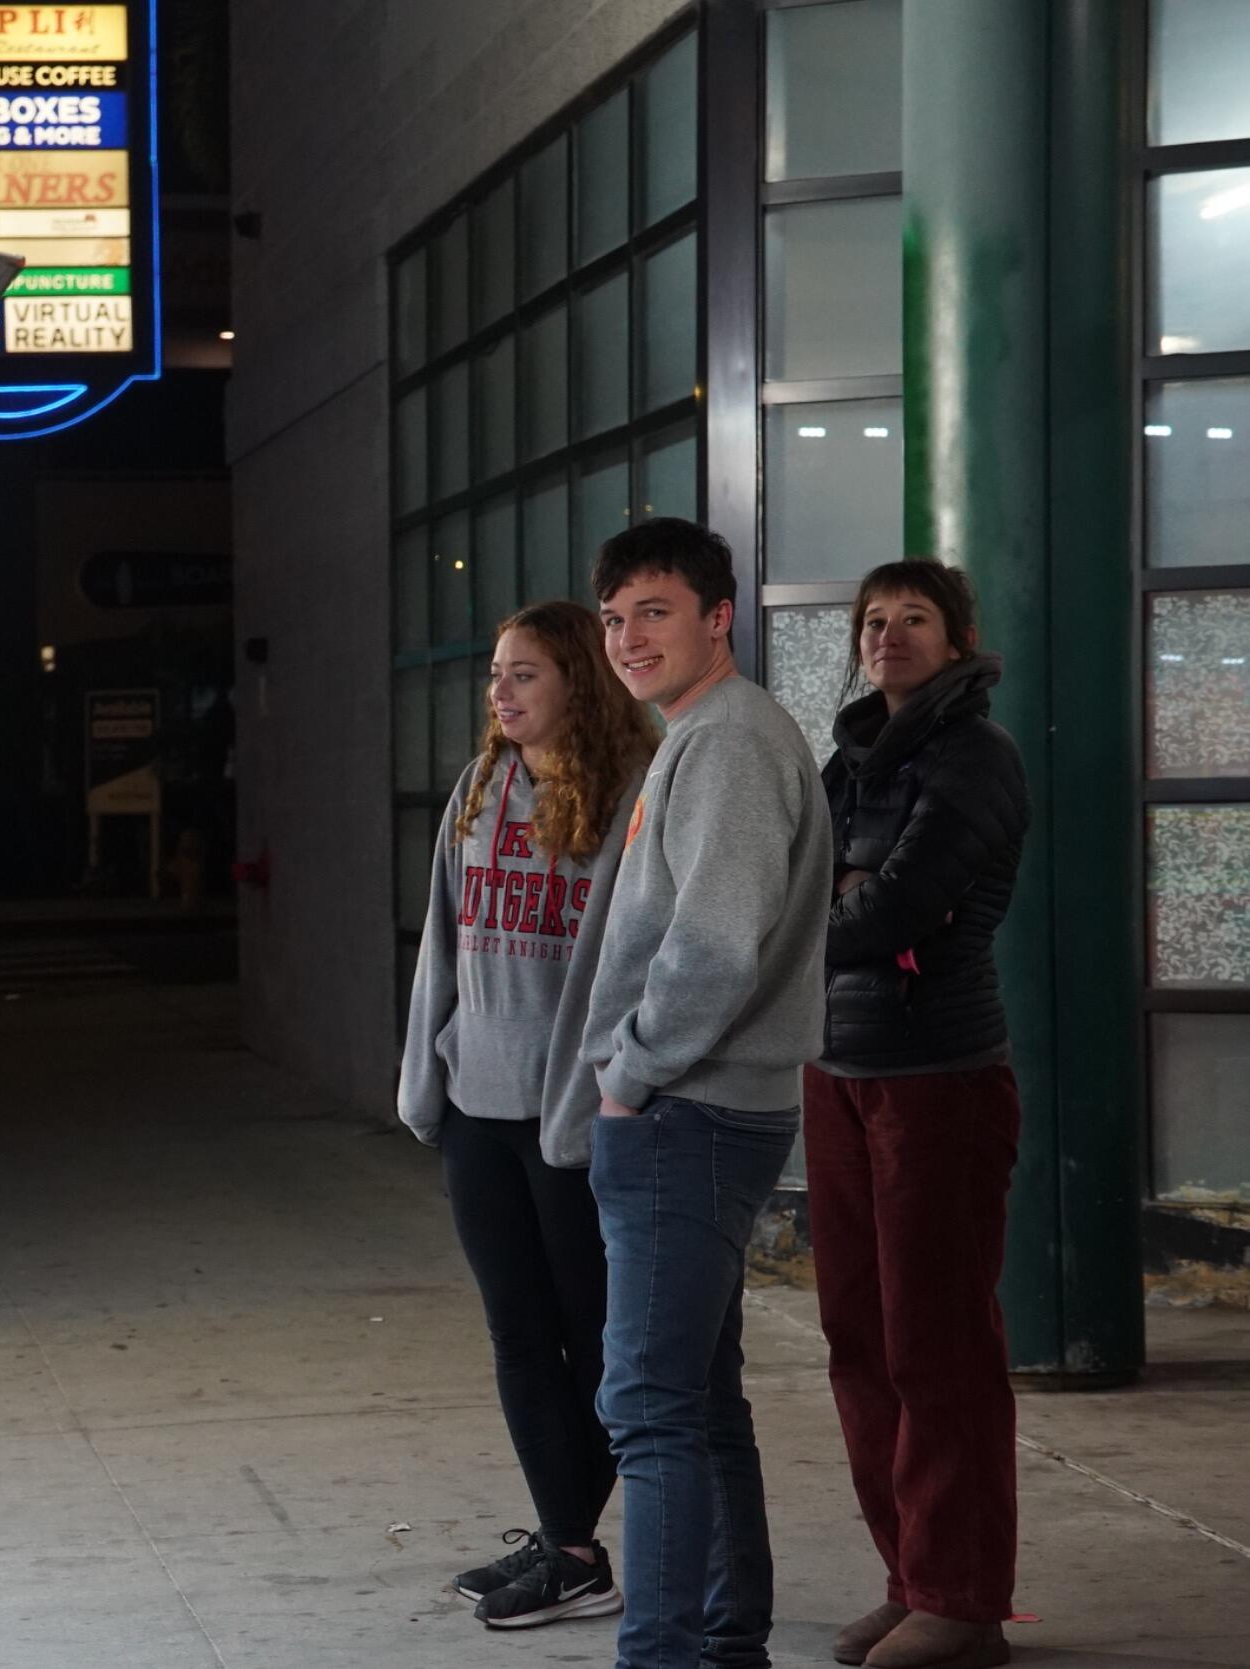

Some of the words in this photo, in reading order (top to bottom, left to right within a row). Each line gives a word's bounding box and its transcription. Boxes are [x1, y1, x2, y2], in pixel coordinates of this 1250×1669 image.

[30, 8, 66, 35] LI
[35, 66, 116, 86] COFFEE
[13, 127, 32, 145] &
[34, 127, 101, 145] MORE
[6, 274, 114, 291] PUNCTURE
[13, 303, 129, 322] VIRTUAL
[14, 327, 126, 347] REALITY
[458, 866, 592, 940] UTGERS
[509, 939, 574, 962] KNIGHT
